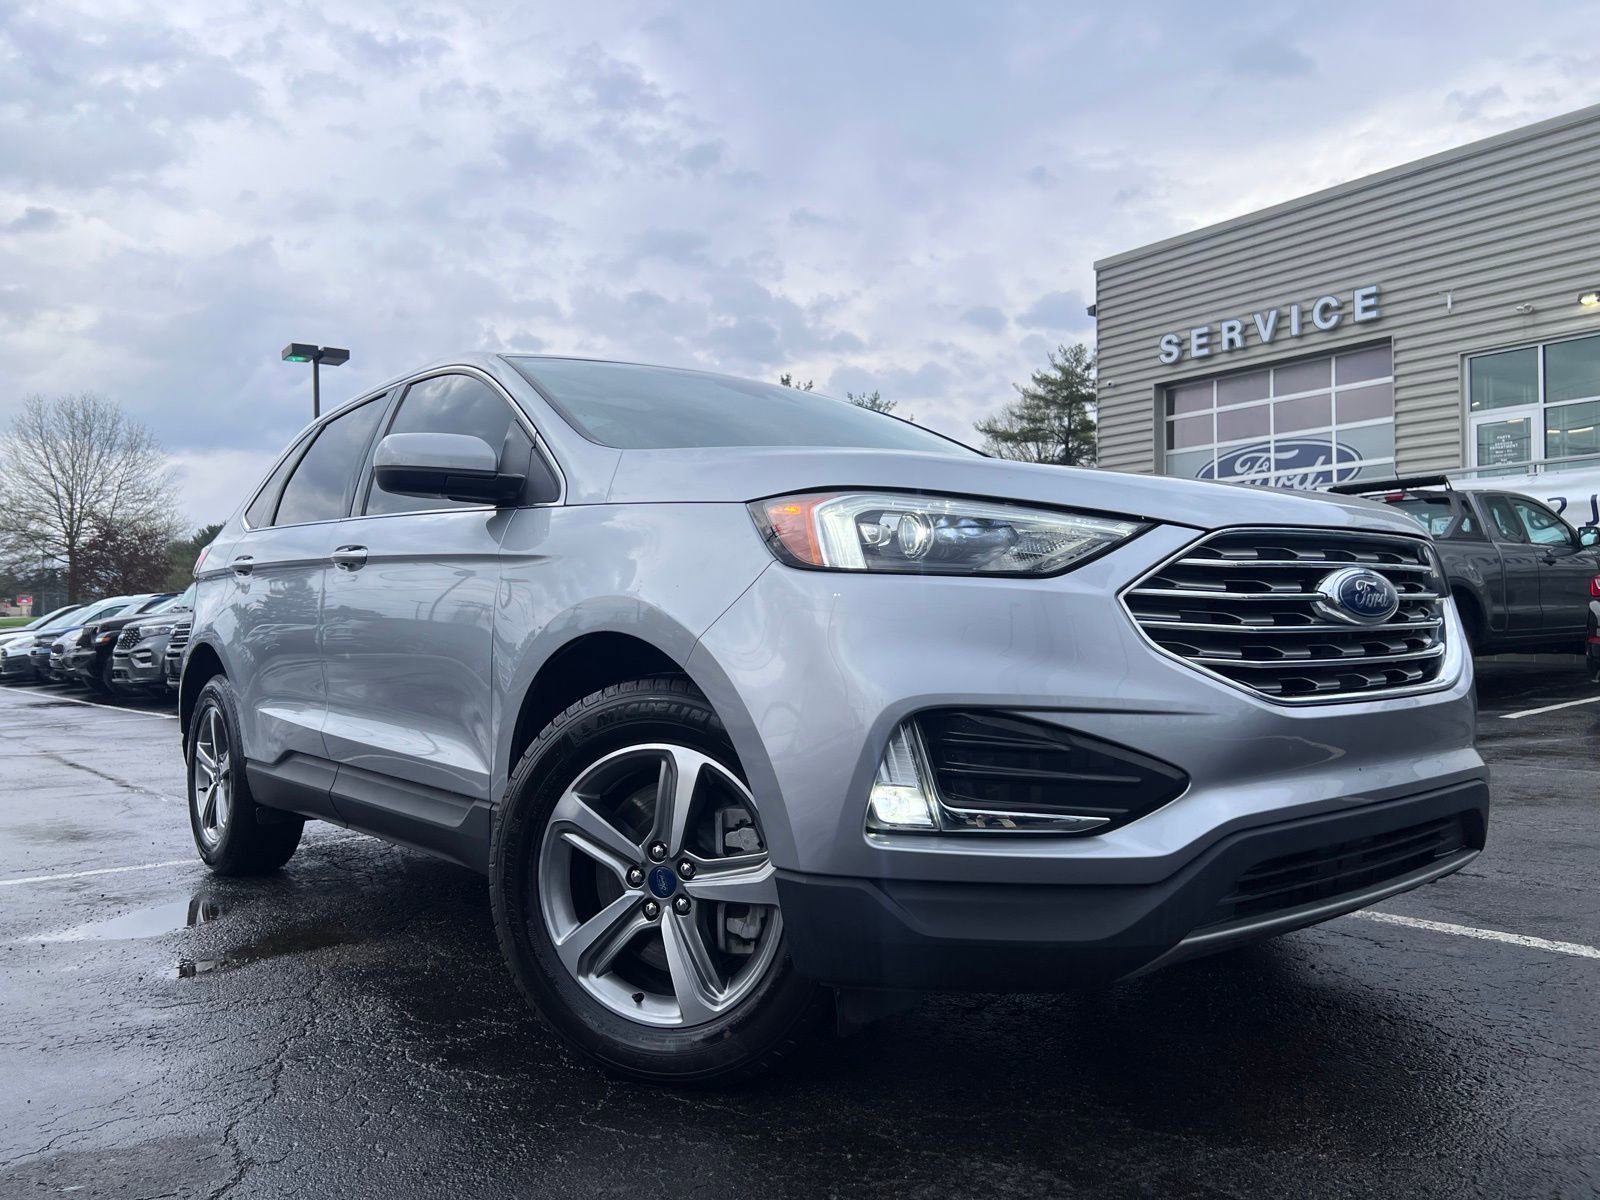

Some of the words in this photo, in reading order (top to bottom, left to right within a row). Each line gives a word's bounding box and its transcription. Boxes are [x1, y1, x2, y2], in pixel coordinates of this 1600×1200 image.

[1159, 285, 1381, 365] SERVICE
[1234, 448, 1324, 490] Ford
[1355, 579, 1389, 608] Ford
